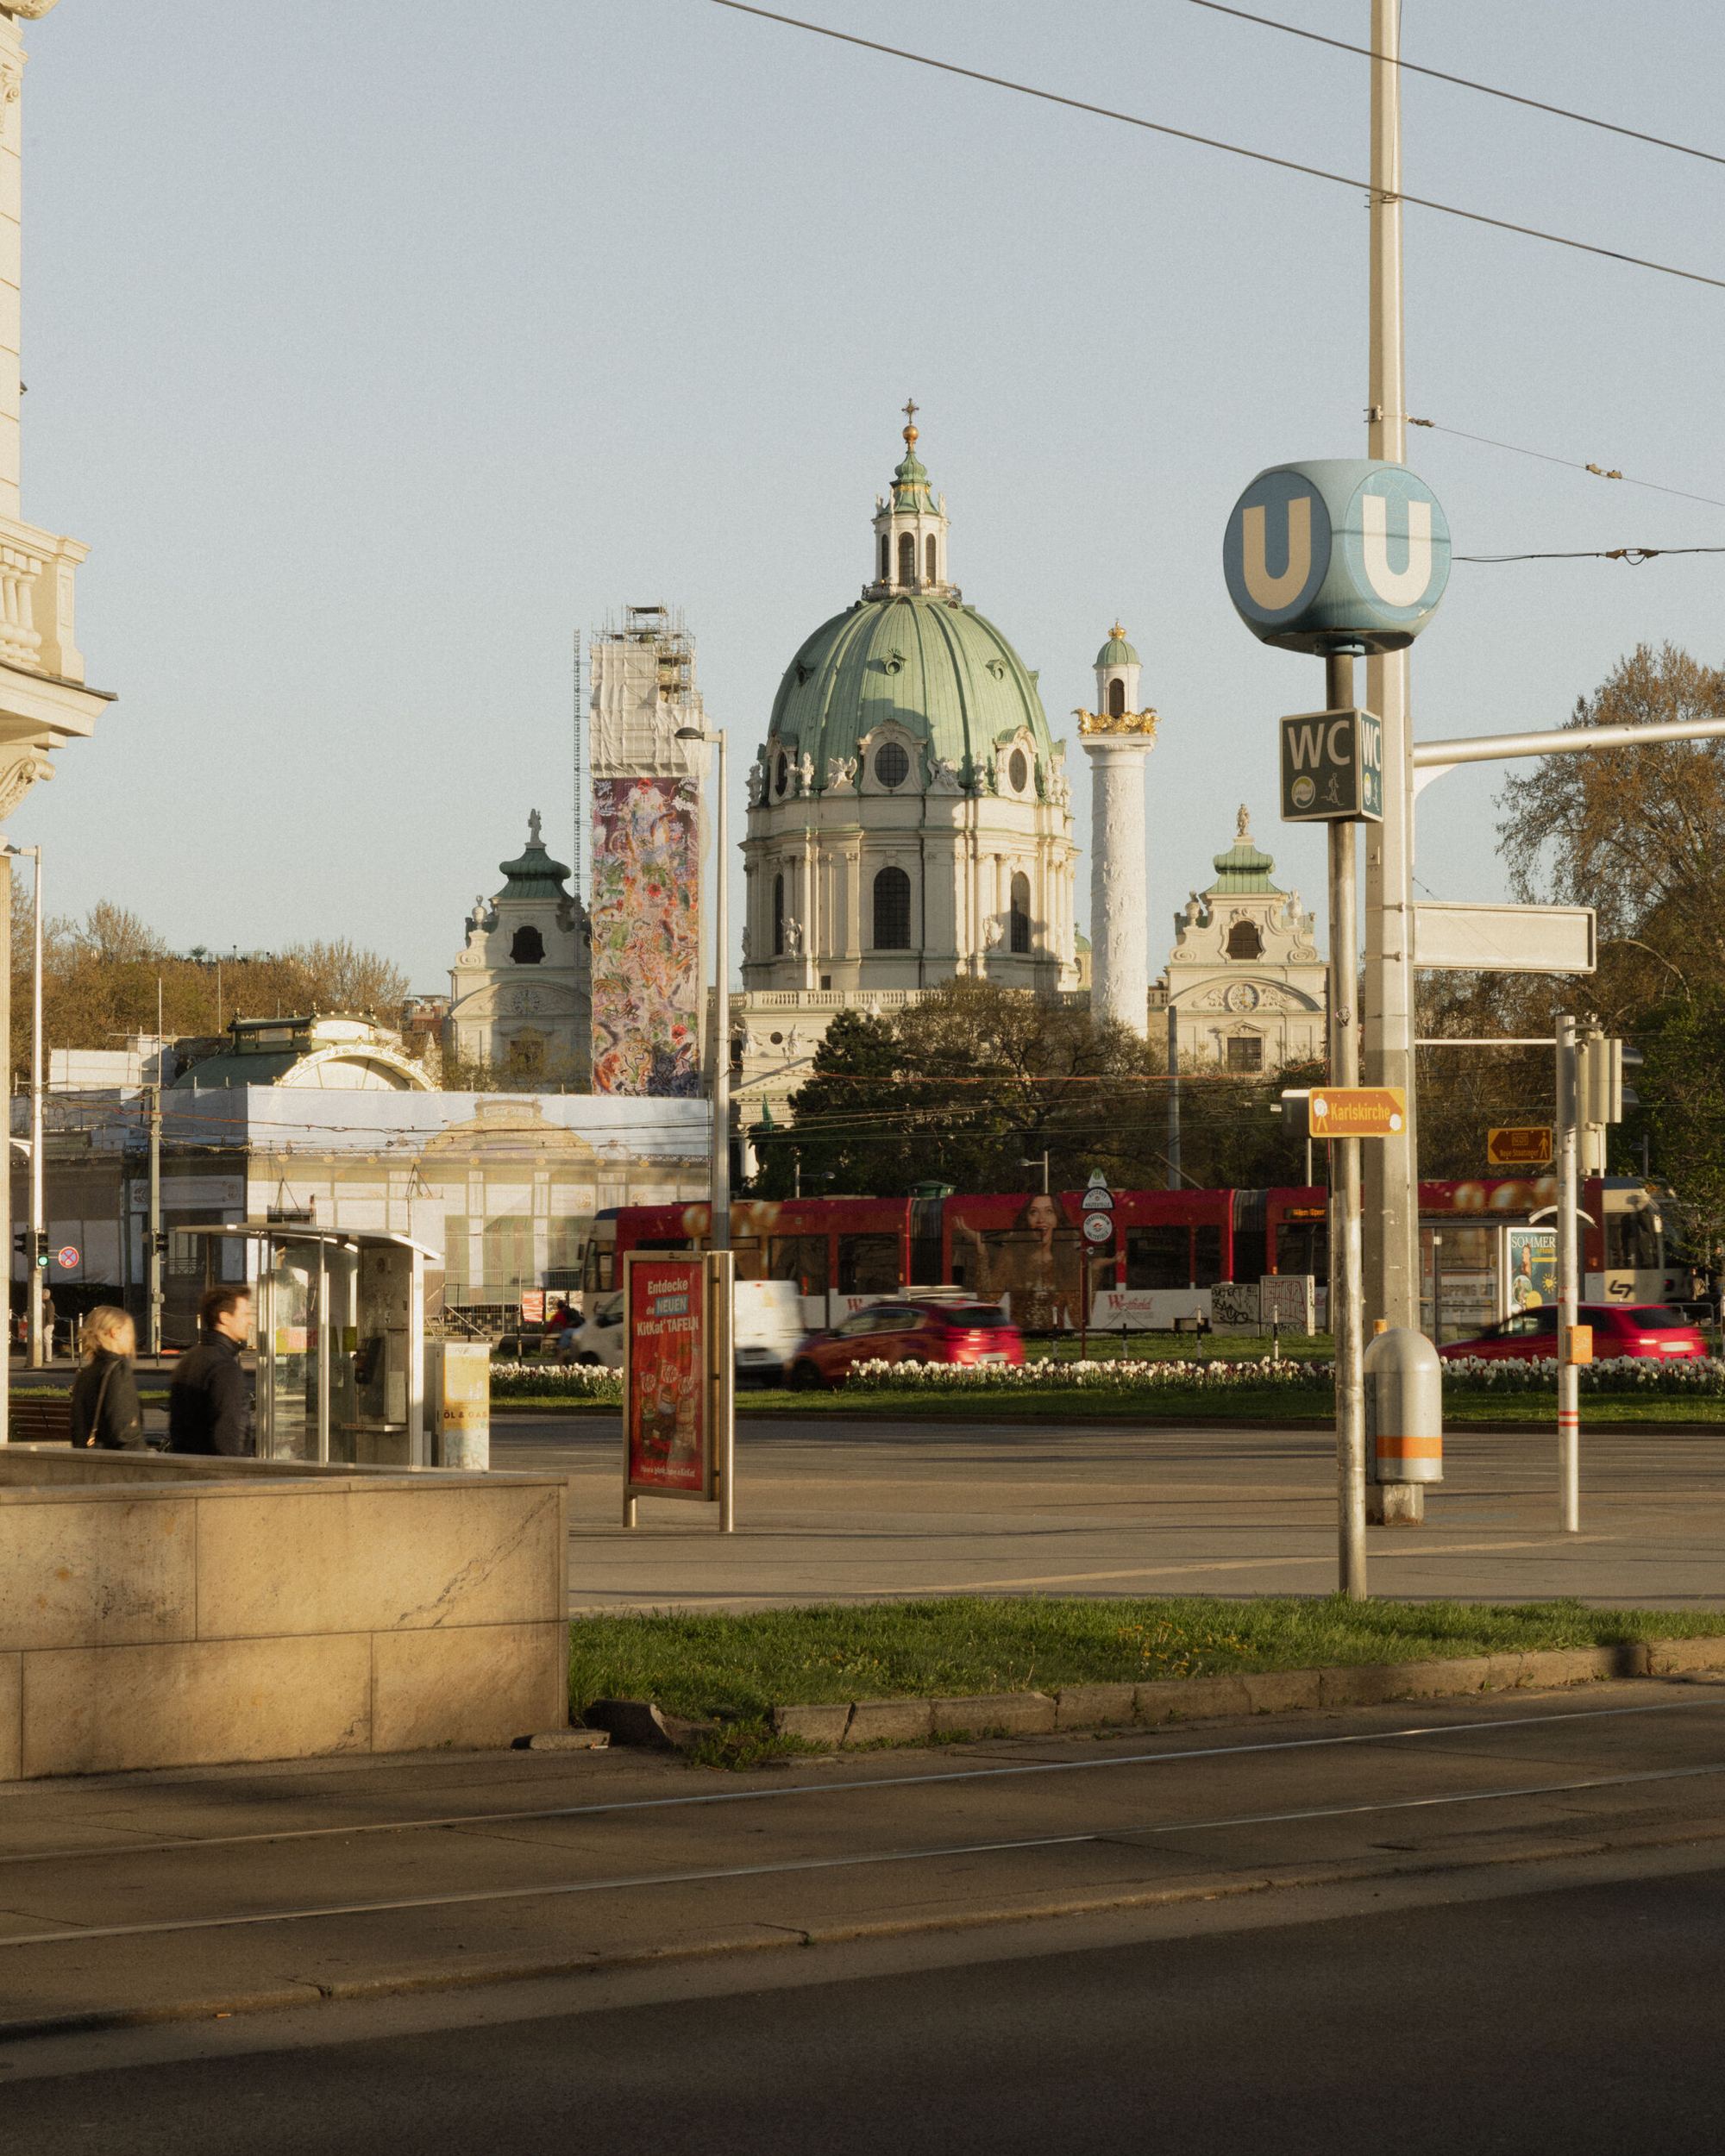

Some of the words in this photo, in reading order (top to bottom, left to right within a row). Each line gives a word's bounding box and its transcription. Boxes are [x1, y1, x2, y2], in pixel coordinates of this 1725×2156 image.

[1243, 497, 1311, 610] U
[1363, 494, 1432, 607] U
[1288, 720, 1350, 770] WC
[1362, 720, 1380, 772] WC
[1331, 1103, 1390, 1120] Karlskirche
[1511, 1236, 1556, 1248] SOMMER
[648, 1278, 688, 1294] Entdecke
[656, 1297, 687, 1313] NEUEN
[667, 1316, 699, 1332] TAFELN
